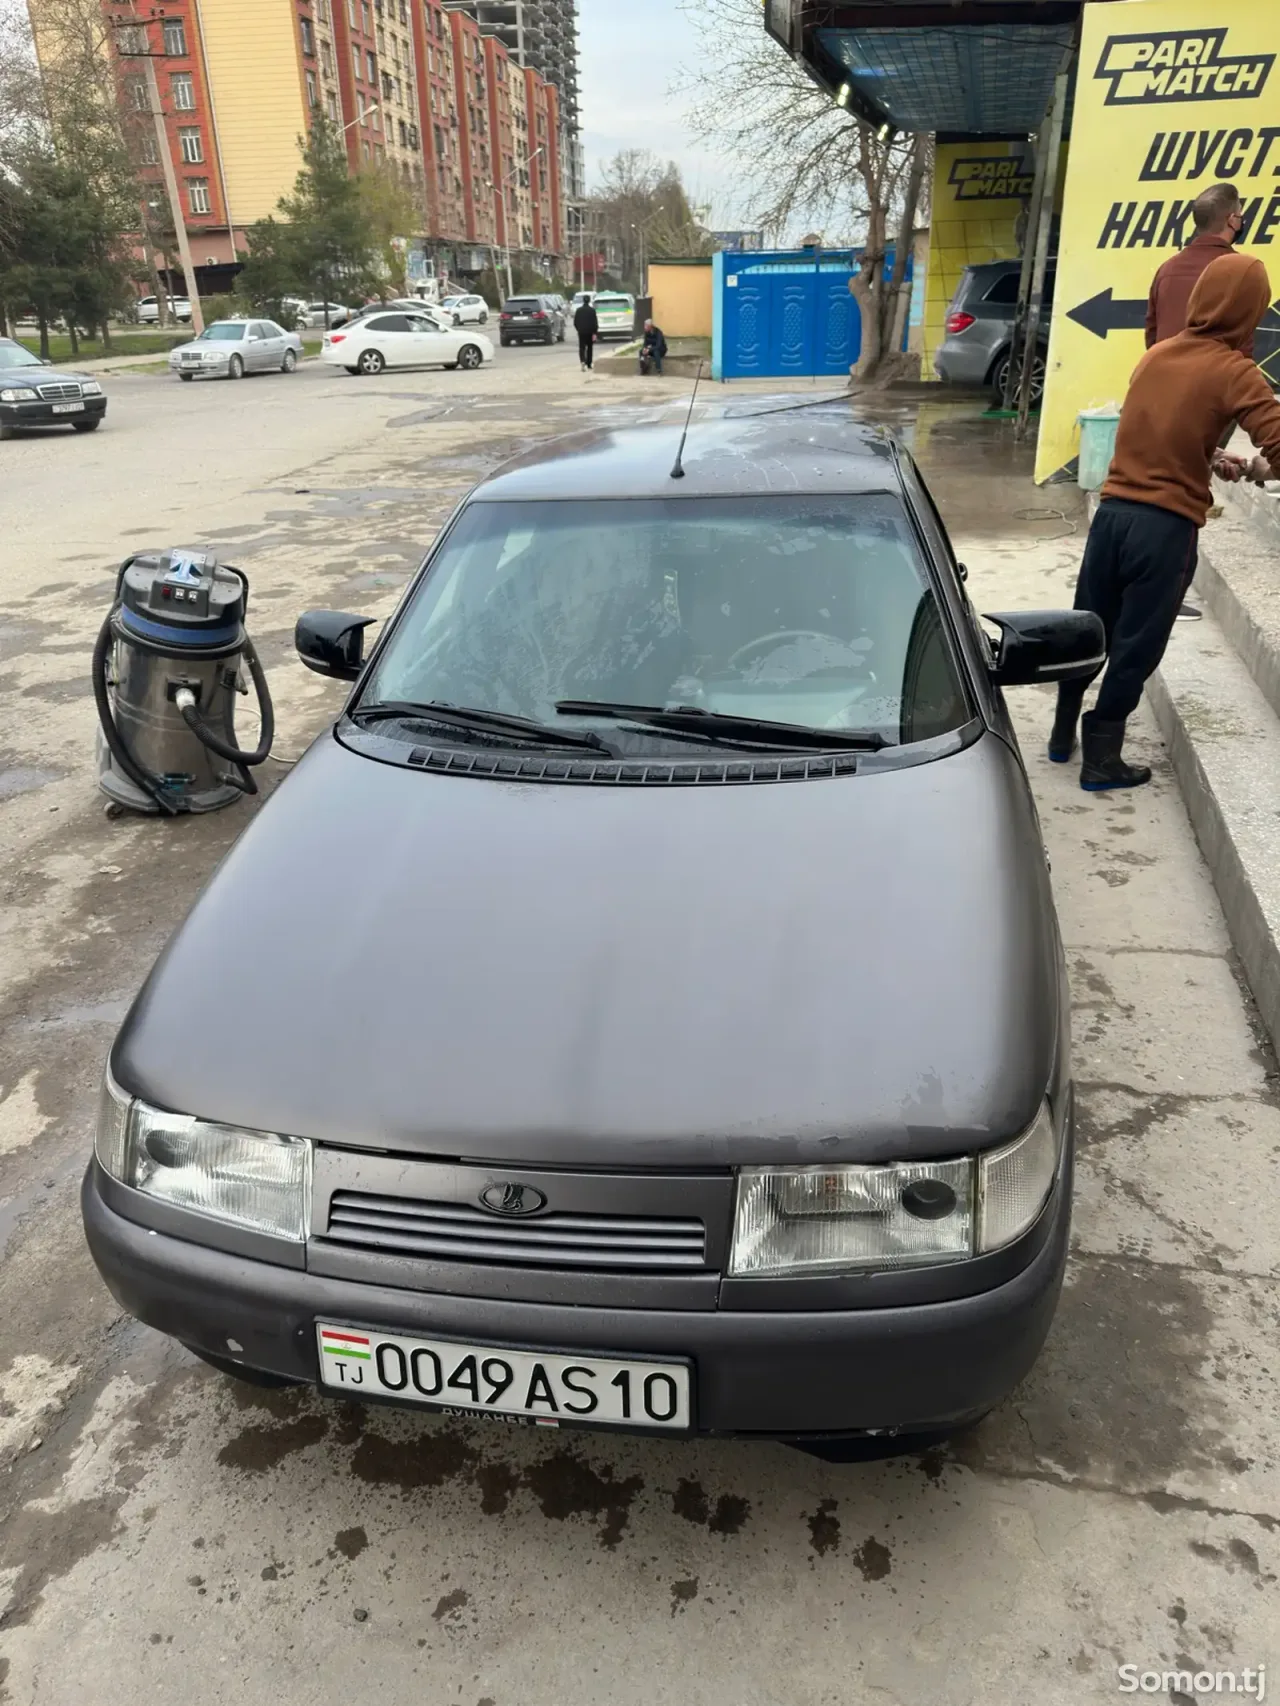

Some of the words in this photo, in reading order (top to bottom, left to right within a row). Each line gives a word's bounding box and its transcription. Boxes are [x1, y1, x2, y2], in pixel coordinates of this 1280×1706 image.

[1104, 37, 1217, 71] PARI
[1114, 63, 1265, 98] MATCH
[1138, 127, 1280, 181] ШУСТ
[955, 161, 1018, 179] PARI
[961, 178, 1033, 195] MATC
[335, 1362, 364, 1384] TJ
